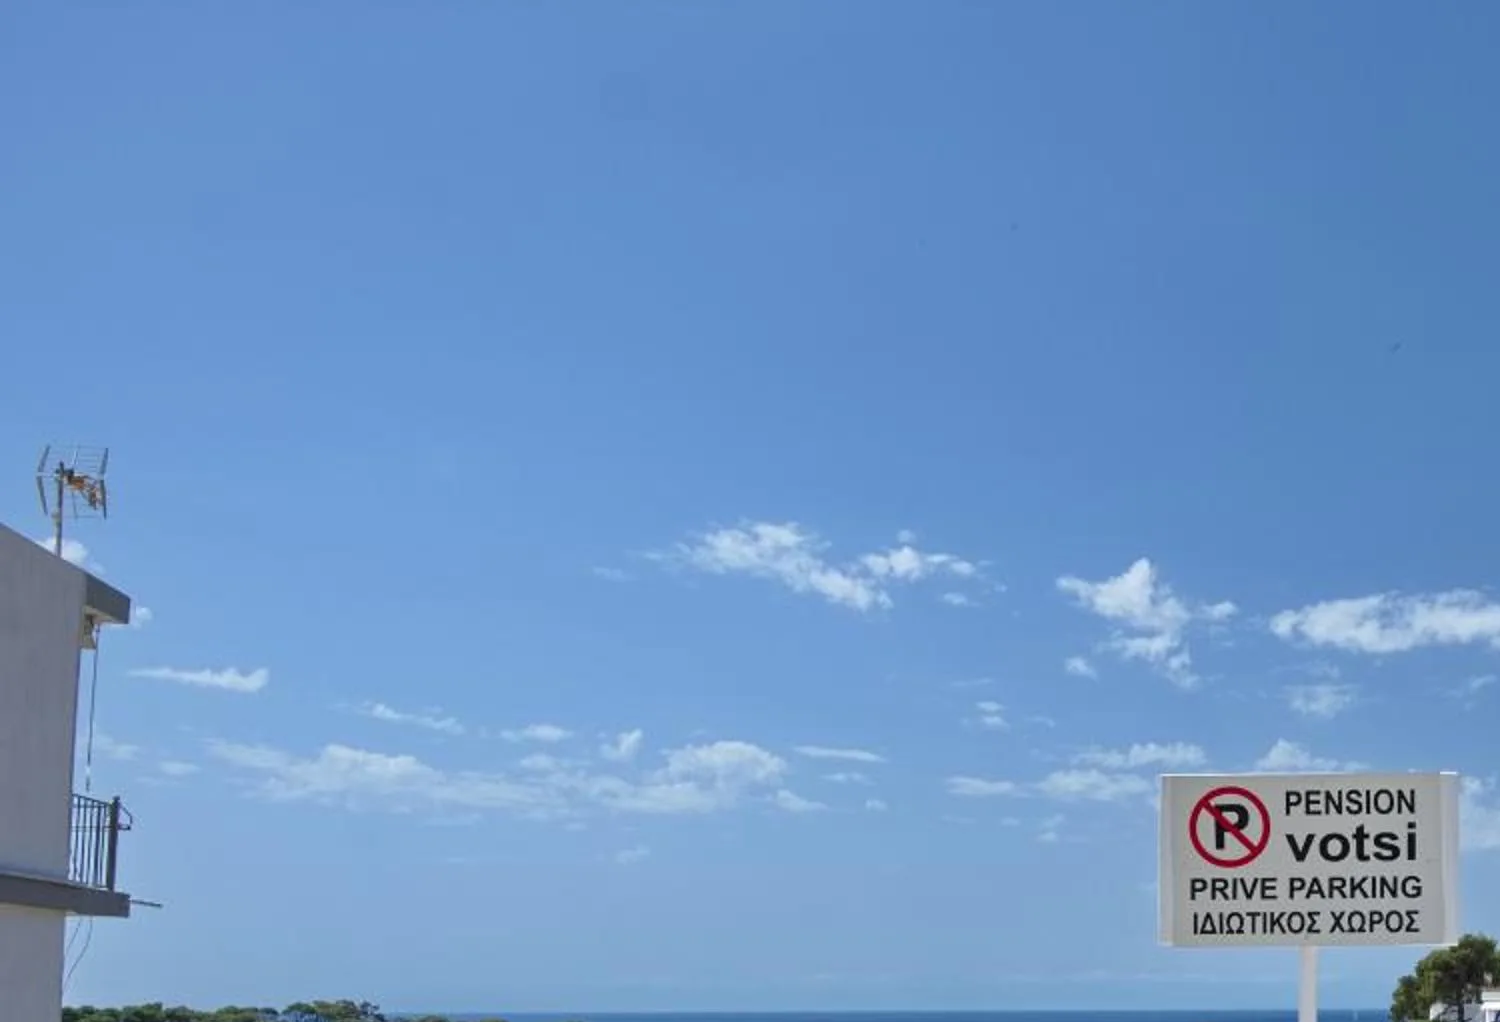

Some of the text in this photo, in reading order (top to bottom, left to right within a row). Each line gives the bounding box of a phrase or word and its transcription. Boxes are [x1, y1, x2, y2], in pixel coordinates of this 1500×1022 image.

[1285, 789, 1415, 815] PENSION
[1286, 822, 1416, 862] votsi
[1190, 876, 1422, 900] PRIVE PARKING
[1193, 910, 1420, 935] ΙΔΙΩΤΙΚΟΣ ΧΩΡΟΣ
